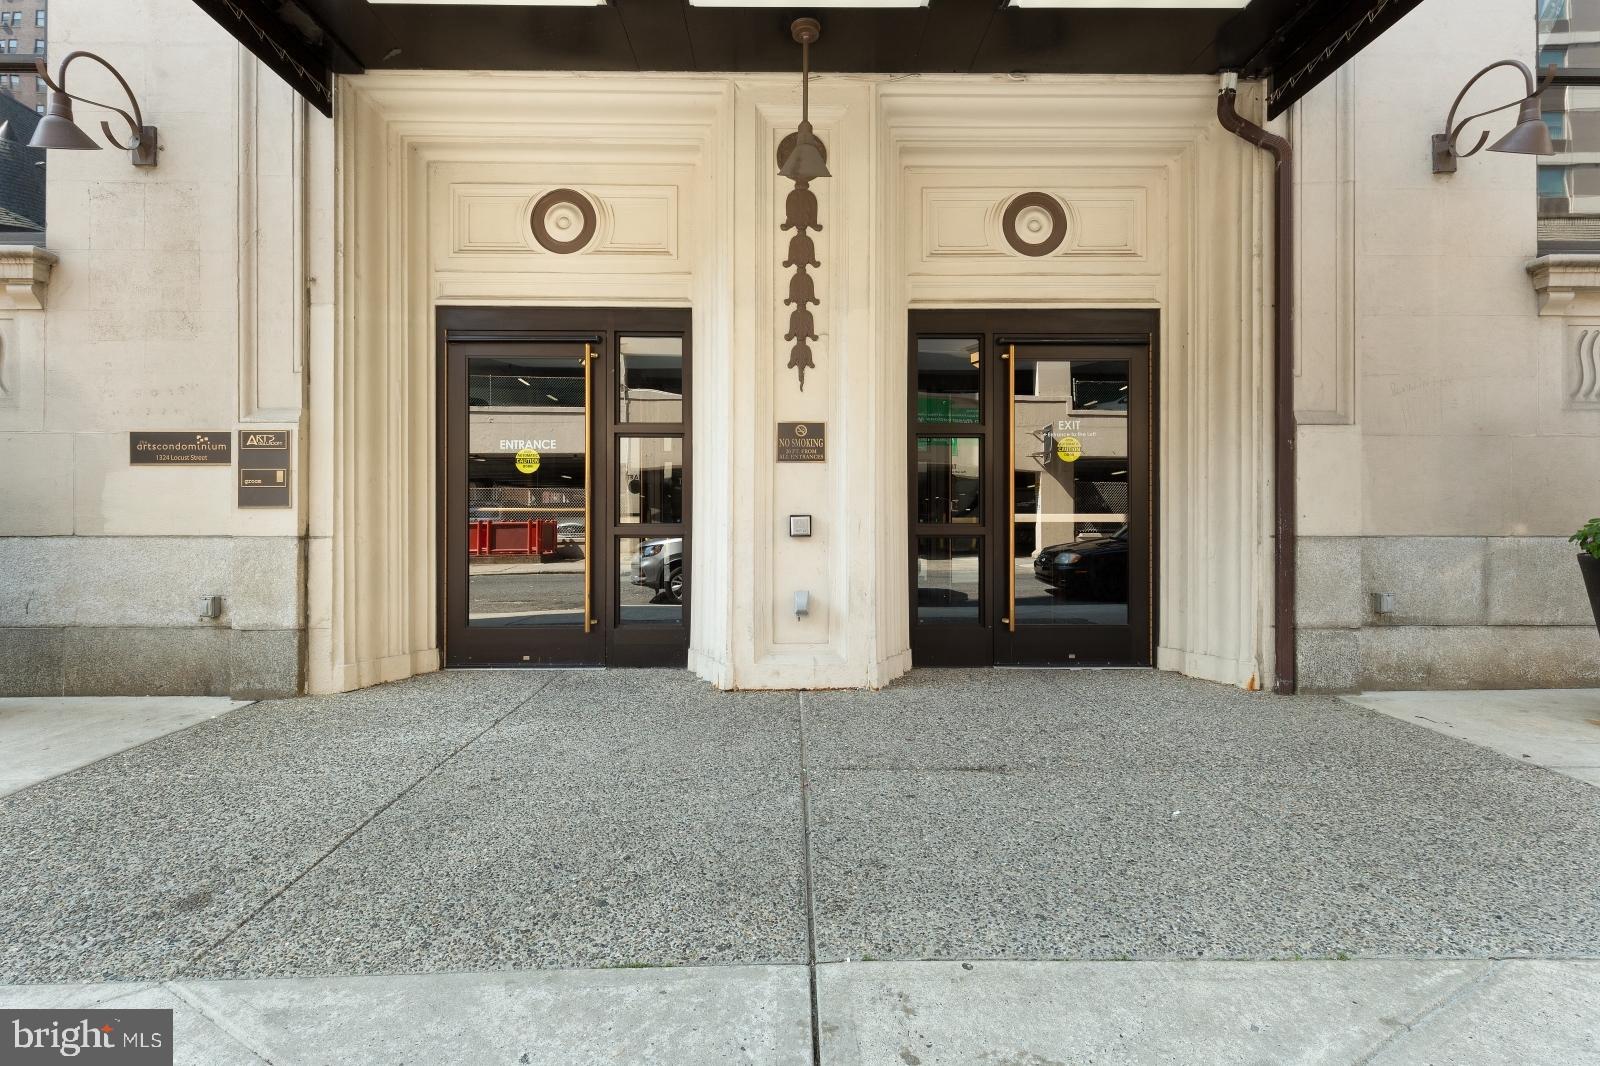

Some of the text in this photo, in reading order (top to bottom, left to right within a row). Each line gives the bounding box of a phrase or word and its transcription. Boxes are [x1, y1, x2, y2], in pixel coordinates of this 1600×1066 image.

[1058, 421, 1080, 430] EXIT
[246, 434, 275, 446] ARTS
[500, 440, 557, 449] ENTRANCE
[779, 438, 824, 448] NO SMOKING
[136, 441, 227, 451] artscondominium
